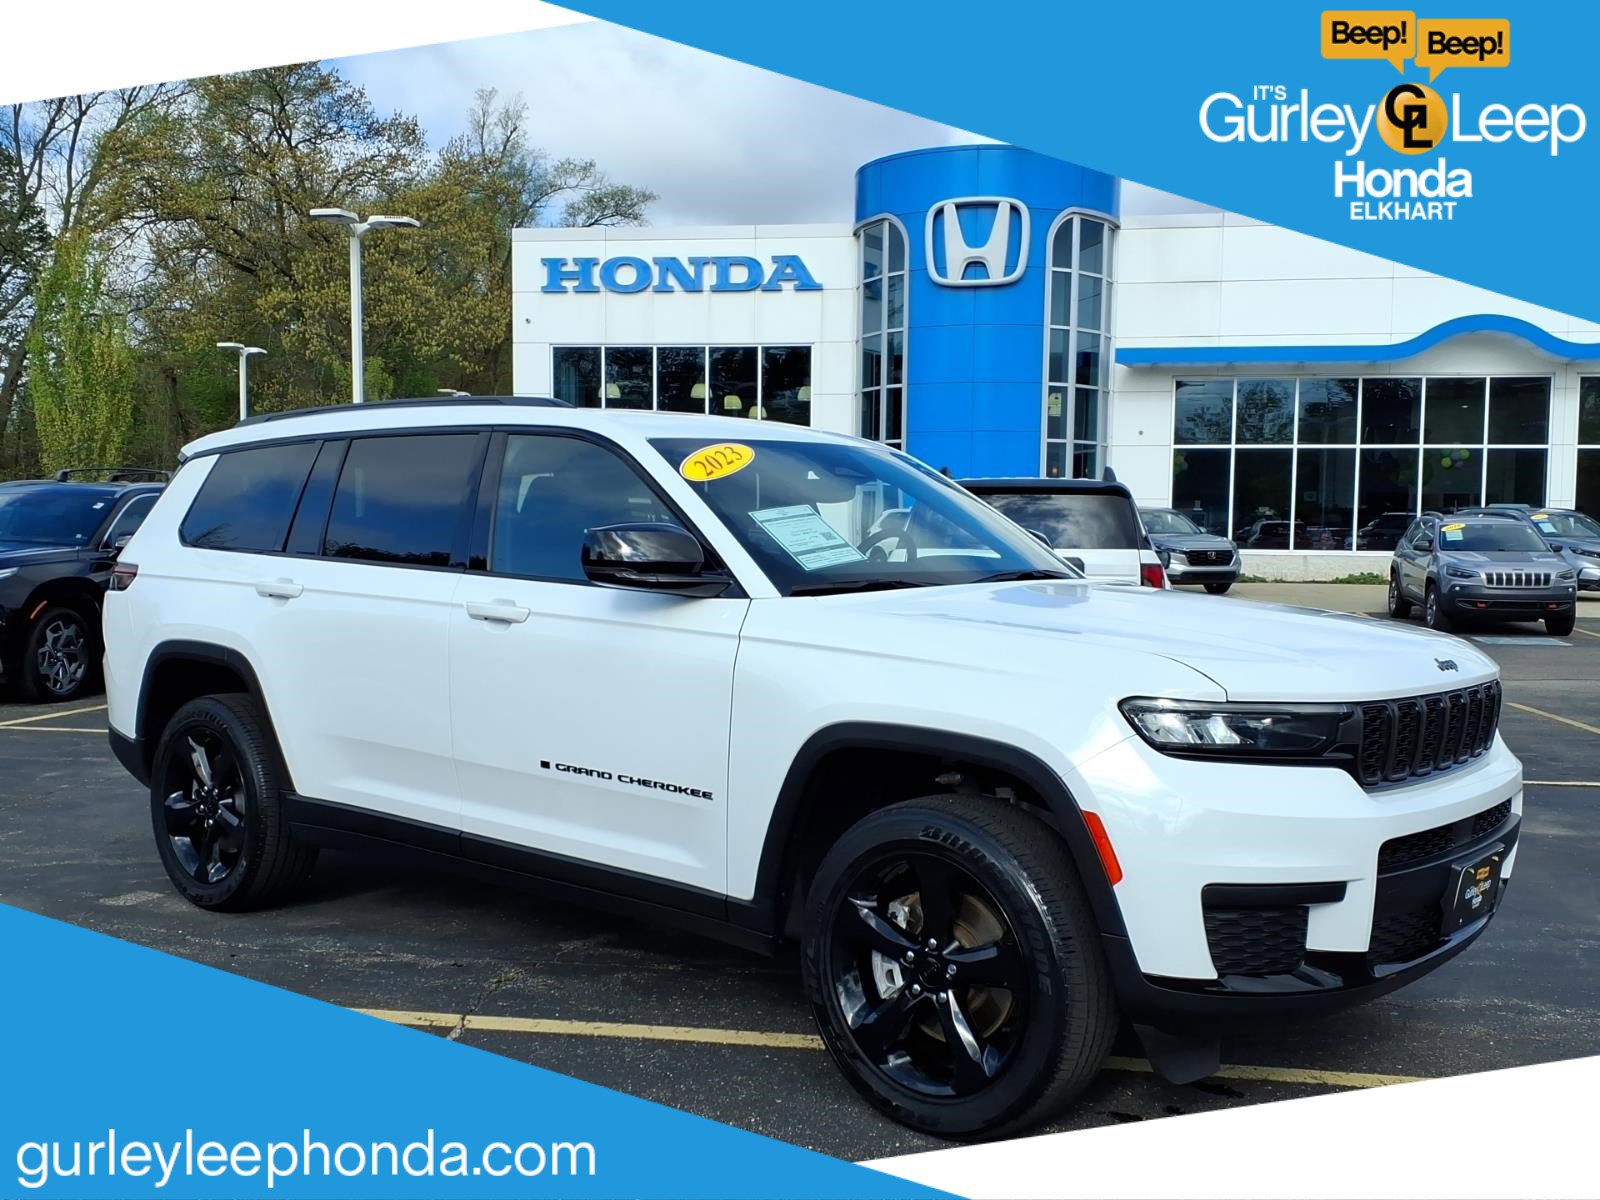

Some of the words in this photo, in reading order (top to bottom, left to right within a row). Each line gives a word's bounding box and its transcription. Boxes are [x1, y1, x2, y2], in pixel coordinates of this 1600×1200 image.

[541, 255, 823, 293] HONDA
[694, 446, 743, 477] 2023
[555, 763, 613, 781] GRAND
[617, 774, 714, 801] CHEROKEE
